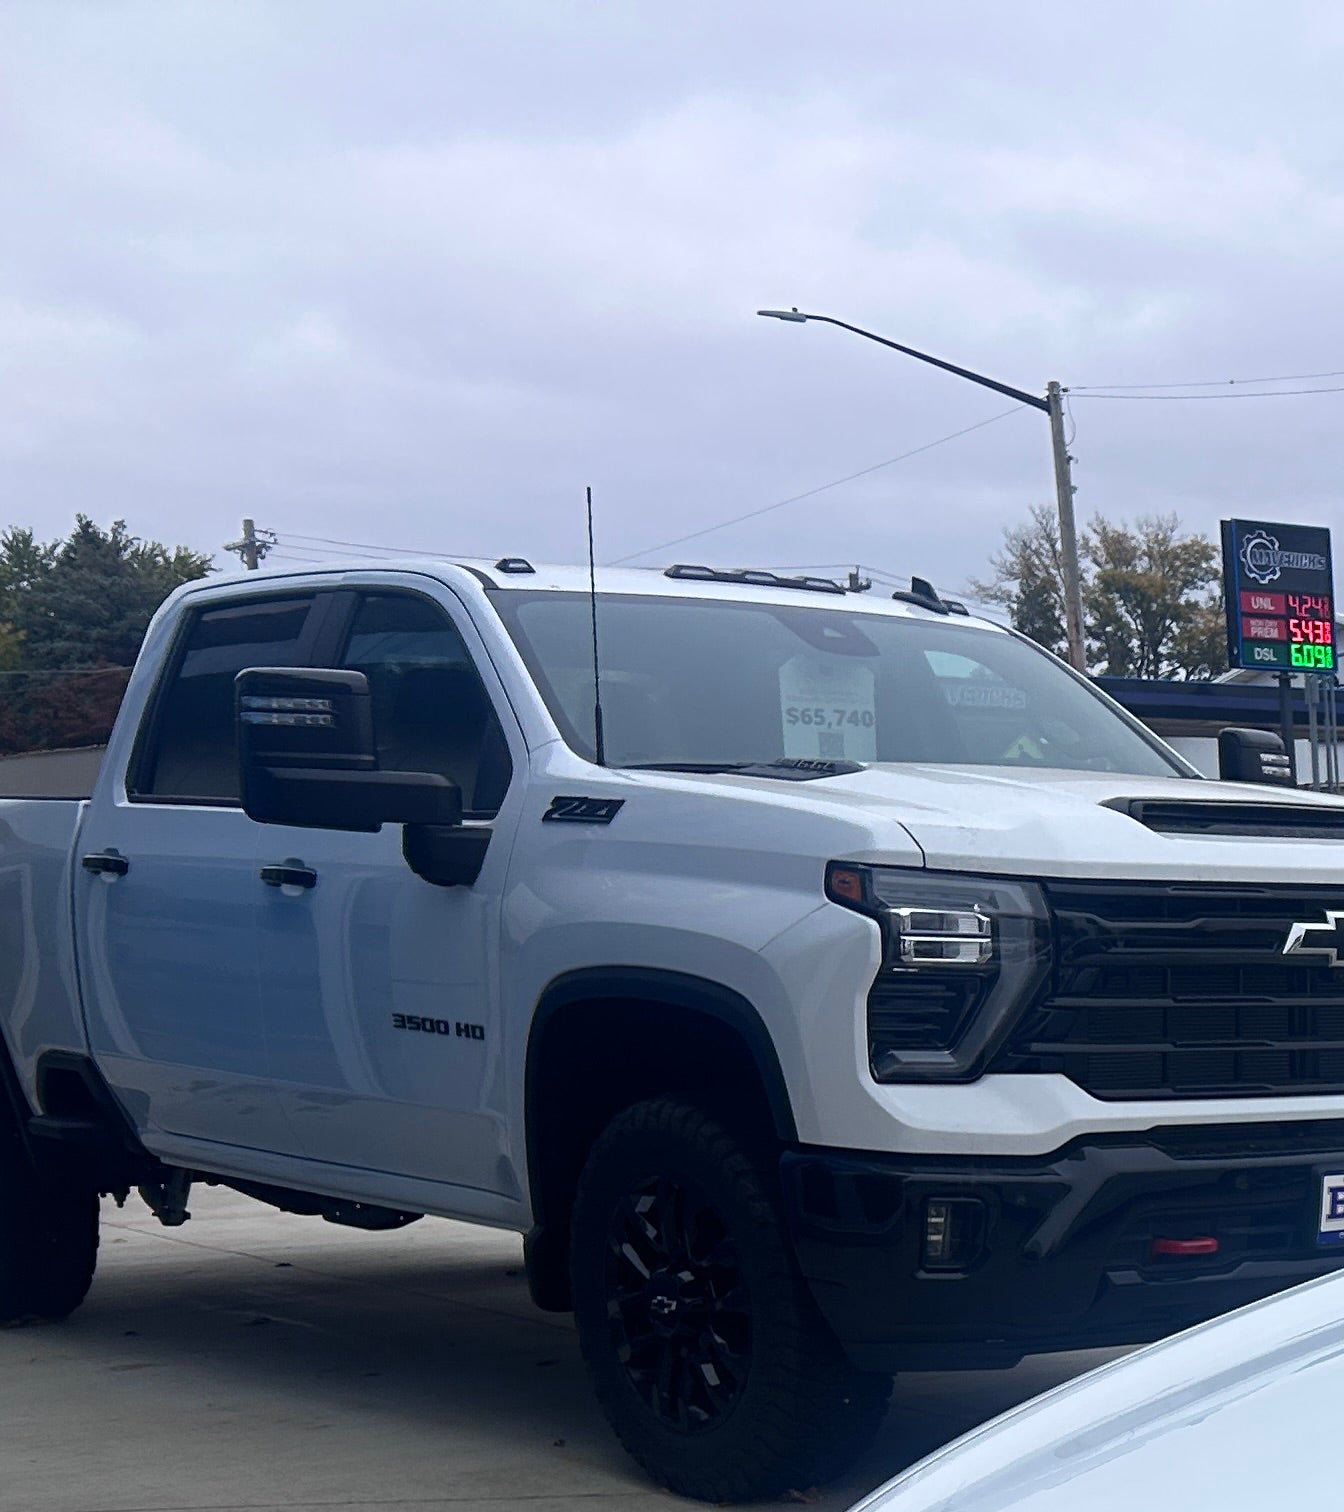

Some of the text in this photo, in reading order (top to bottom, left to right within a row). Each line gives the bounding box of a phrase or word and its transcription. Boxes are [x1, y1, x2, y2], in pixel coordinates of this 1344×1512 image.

[1251, 596, 1276, 610] UNL
[1254, 647, 1278, 661] DSL
[785, 706, 874, 729] $65,740
[392, 1013, 484, 1040] 3500 HD
